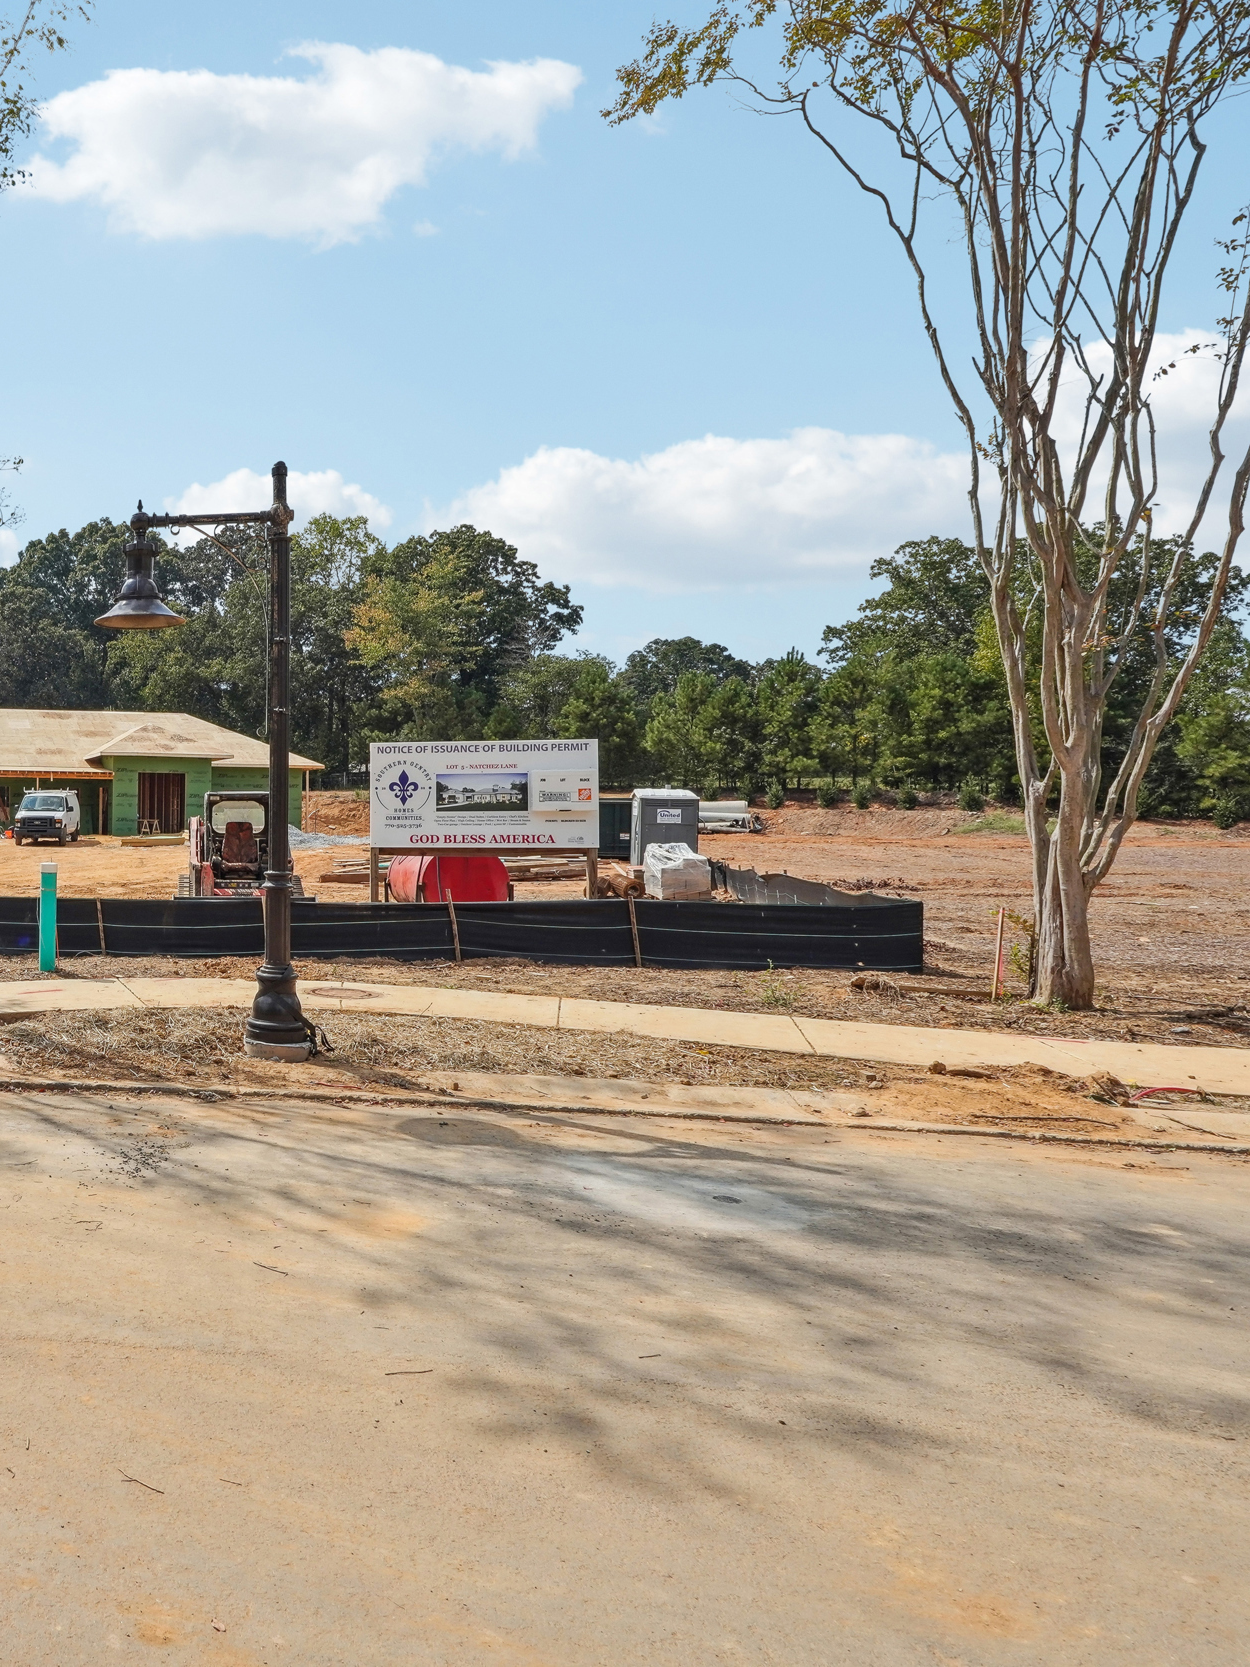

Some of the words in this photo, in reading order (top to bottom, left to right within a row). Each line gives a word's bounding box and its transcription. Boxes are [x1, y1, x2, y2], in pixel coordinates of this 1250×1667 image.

[377, 746, 413, 754] NOTICE
[431, 745, 480, 753] ISSUANCE
[482, 744, 496, 752] OF
[499, 744, 548, 752] BUILDING
[551, 743, 589, 751] PERMIT
[375, 760, 407, 782] SOUTHERN
[410, 762, 432, 782] GENTRY
[410, 834, 439, 844] GOD
[443, 834, 486, 844] BLESS
[489, 834, 556, 844] AMERICA
